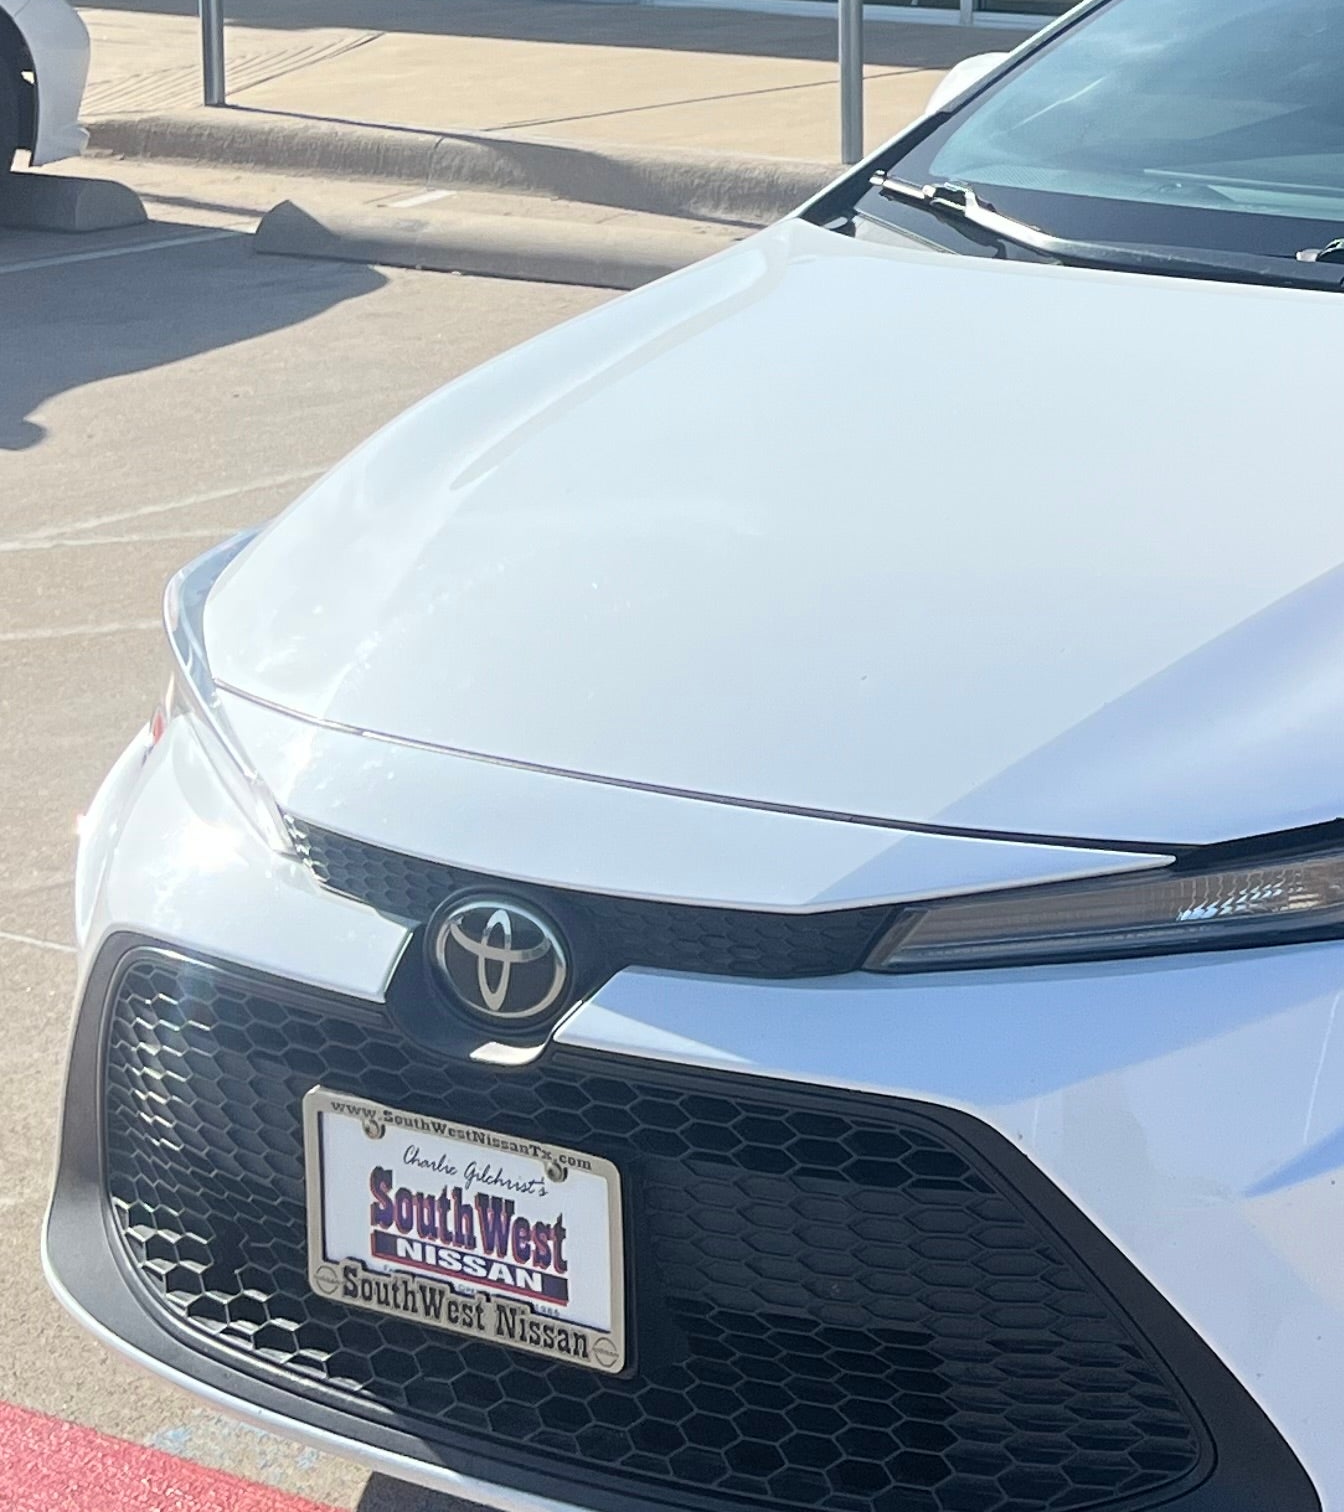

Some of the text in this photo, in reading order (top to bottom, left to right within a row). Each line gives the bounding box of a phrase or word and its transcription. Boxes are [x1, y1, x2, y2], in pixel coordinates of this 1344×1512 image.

[403, 1144, 549, 1197] Charlie Gilchrist's
[370, 1165, 568, 1274] SouthWest
[396, 1237, 543, 1293] NISSAN
[342, 1265, 590, 1359] SouthWest Nissan
